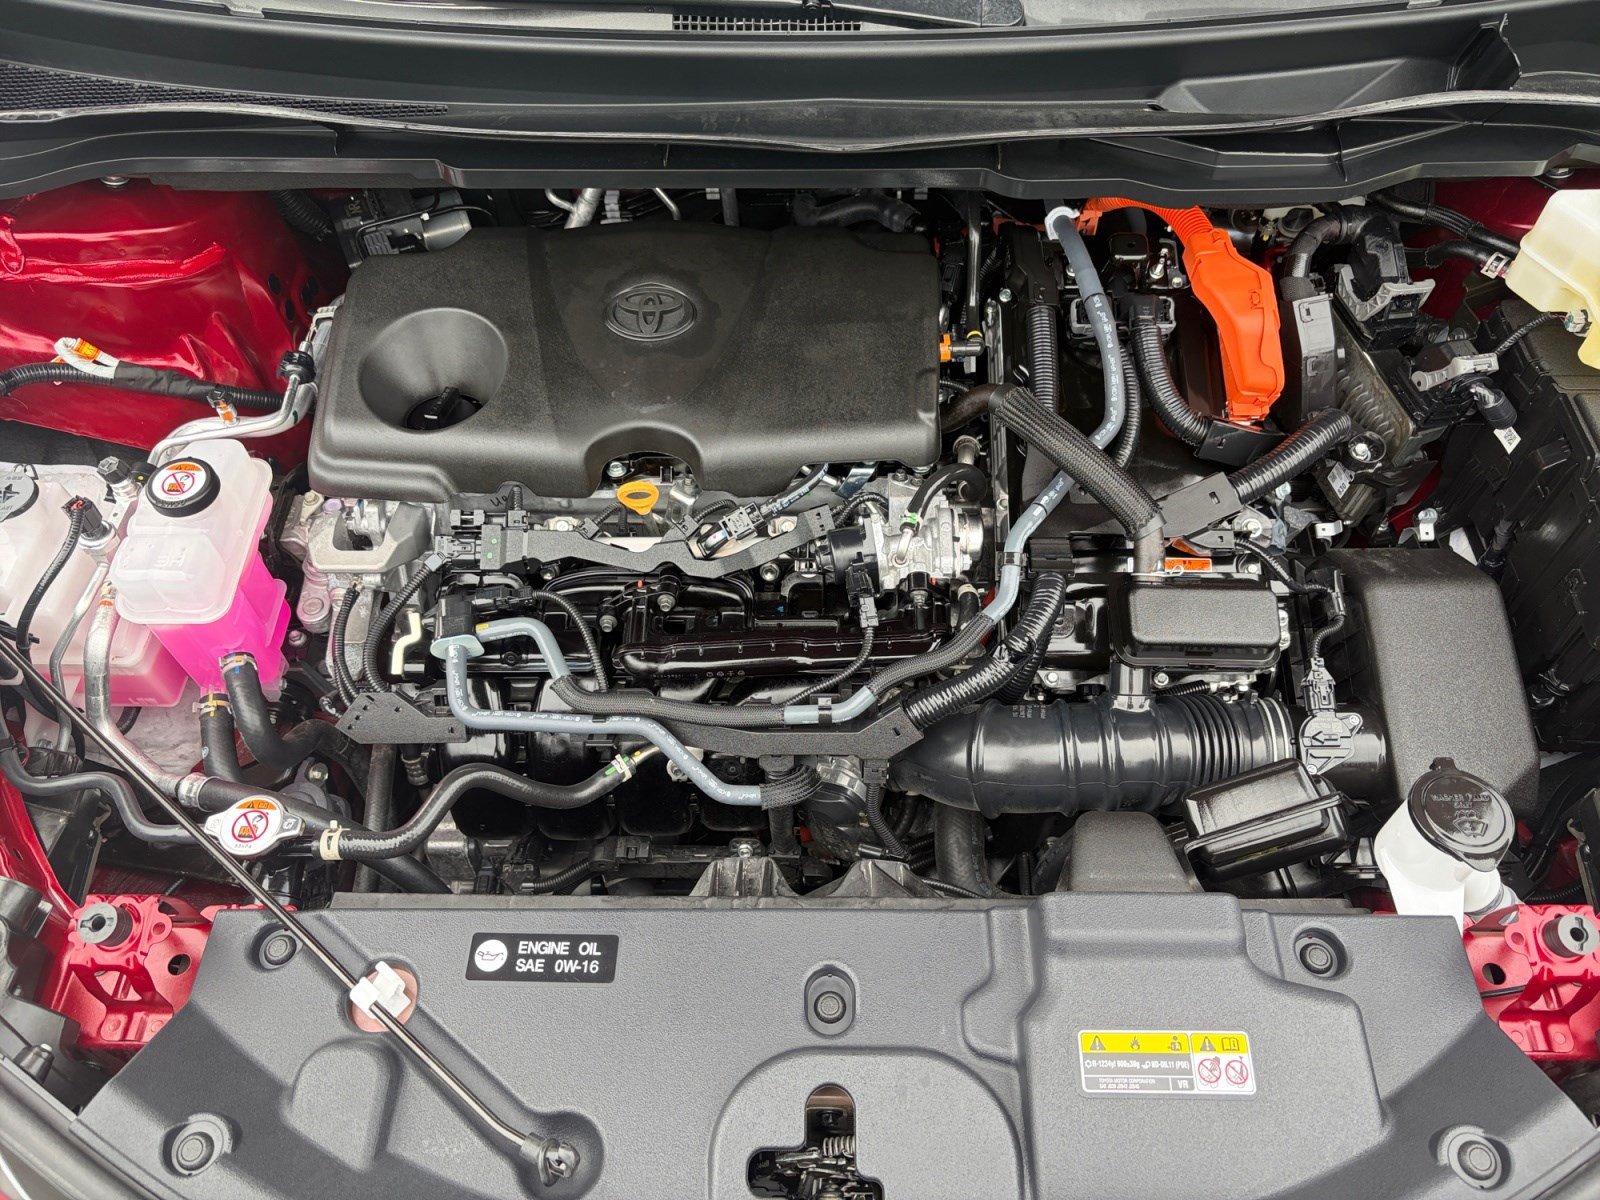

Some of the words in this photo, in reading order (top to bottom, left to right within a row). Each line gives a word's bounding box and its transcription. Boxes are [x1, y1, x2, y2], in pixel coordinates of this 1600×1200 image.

[518, 941, 570, 955] ENGINE
[578, 942, 601, 956] OIL
[515, 959, 545, 973] SAE
[554, 960, 599, 974] 0W-16
[1177, 1079, 1189, 1089] VR
